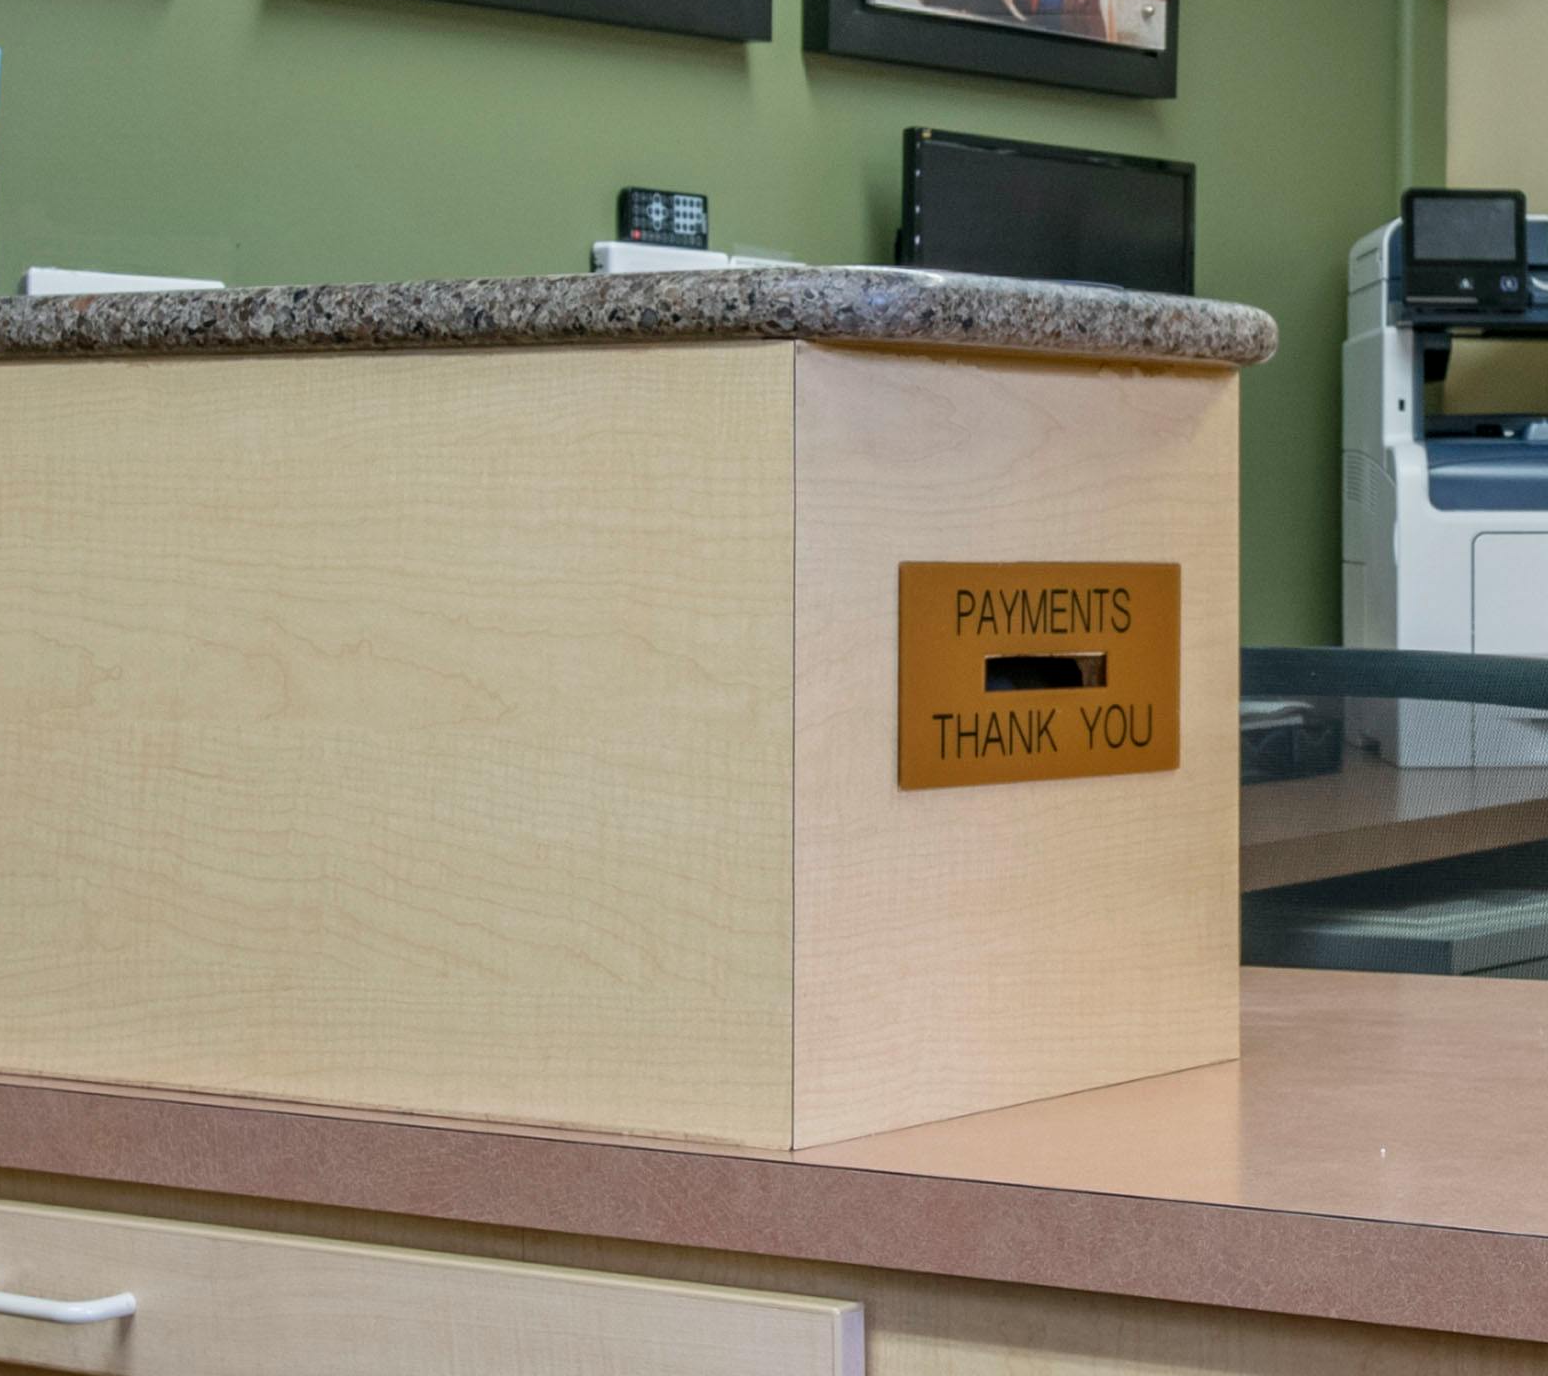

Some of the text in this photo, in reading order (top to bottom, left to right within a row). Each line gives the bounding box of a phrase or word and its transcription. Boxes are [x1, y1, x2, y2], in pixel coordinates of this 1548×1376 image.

[956, 588, 1132, 636] PAYMENTS
[932, 704, 1153, 760] THANK YOU
